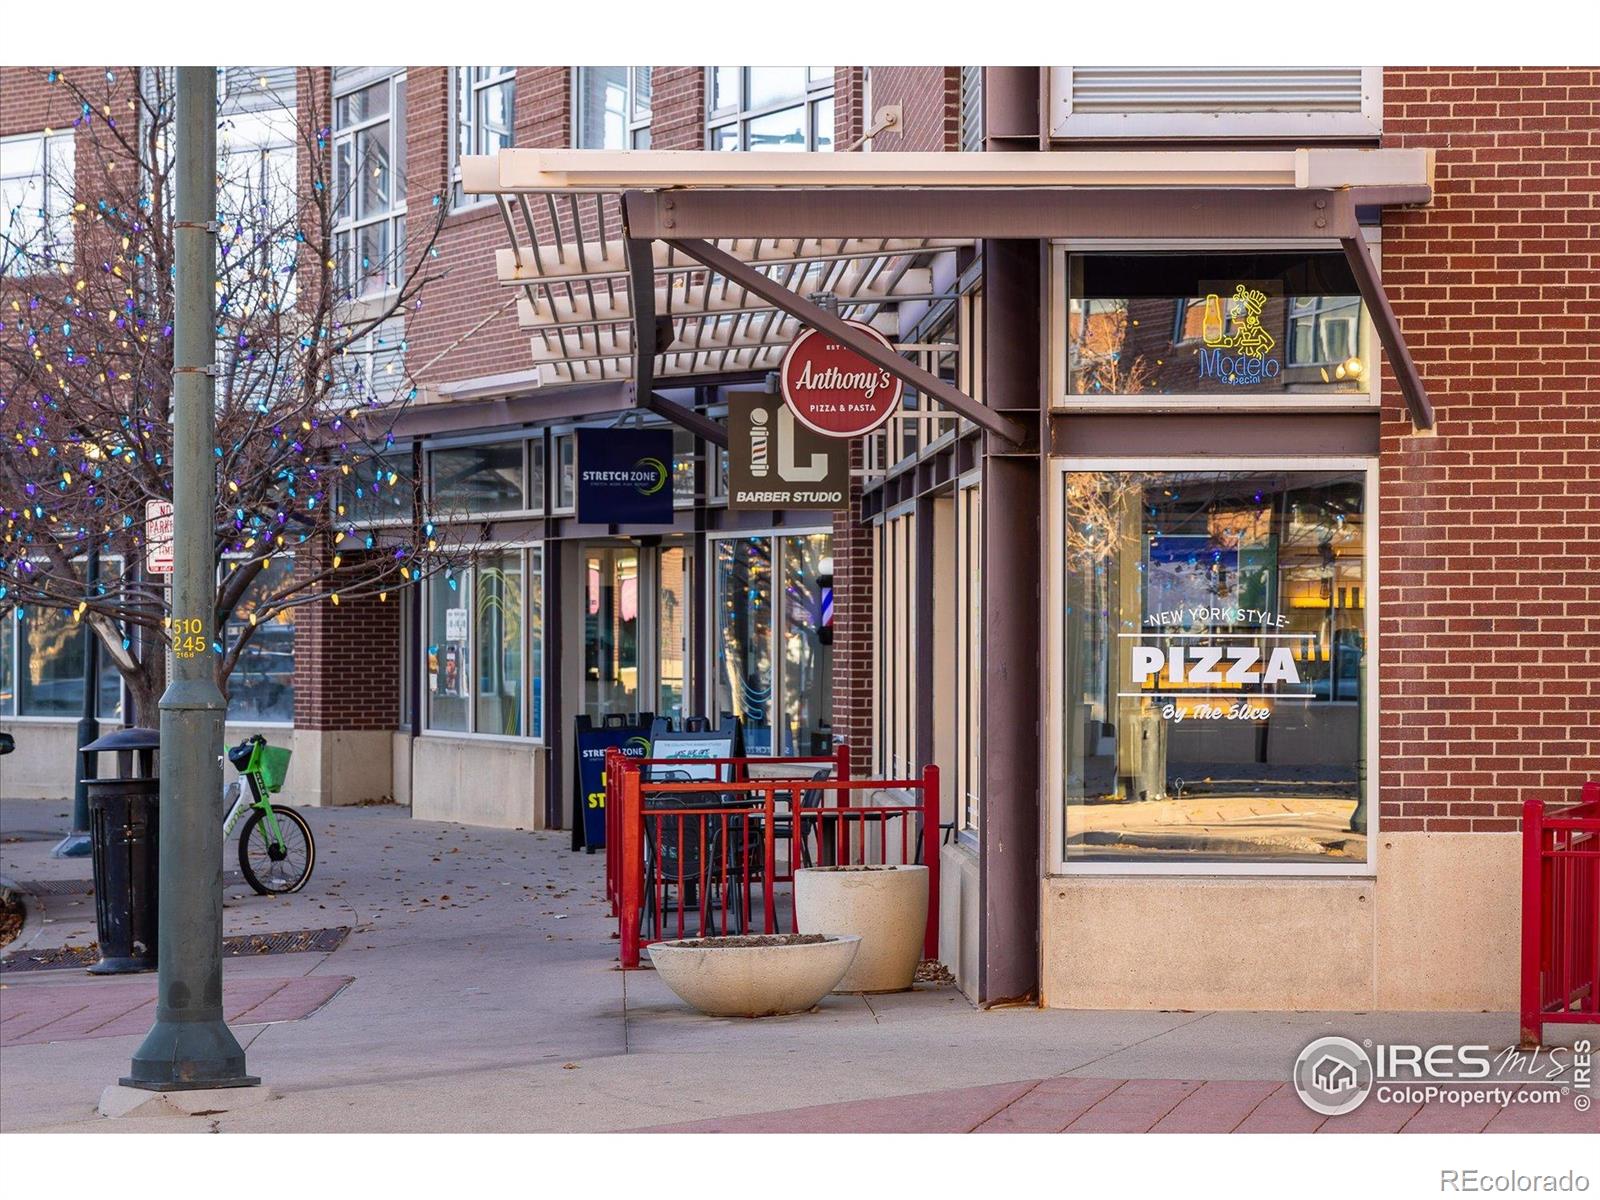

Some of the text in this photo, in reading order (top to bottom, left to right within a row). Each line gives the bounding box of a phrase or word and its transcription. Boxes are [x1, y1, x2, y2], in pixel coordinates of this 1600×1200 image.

[1199, 348, 1280, 378] Modelo
[795, 360, 891, 399] Anthony's
[809, 404, 877, 412] PIZZA & PASTA
[583, 471, 656, 482] STRETCH ZONE
[736, 491, 842, 503] BARBER STUDIO
[159, 505, 172, 516] NO
[1188, 607, 1232, 621] YORK
[173, 618, 202, 634] 510
[173, 636, 206, 652] 245
[1132, 646, 1301, 684] PIZZA
[1162, 703, 1271, 723] By The Slice
[622, 747, 643, 757] ZONE
